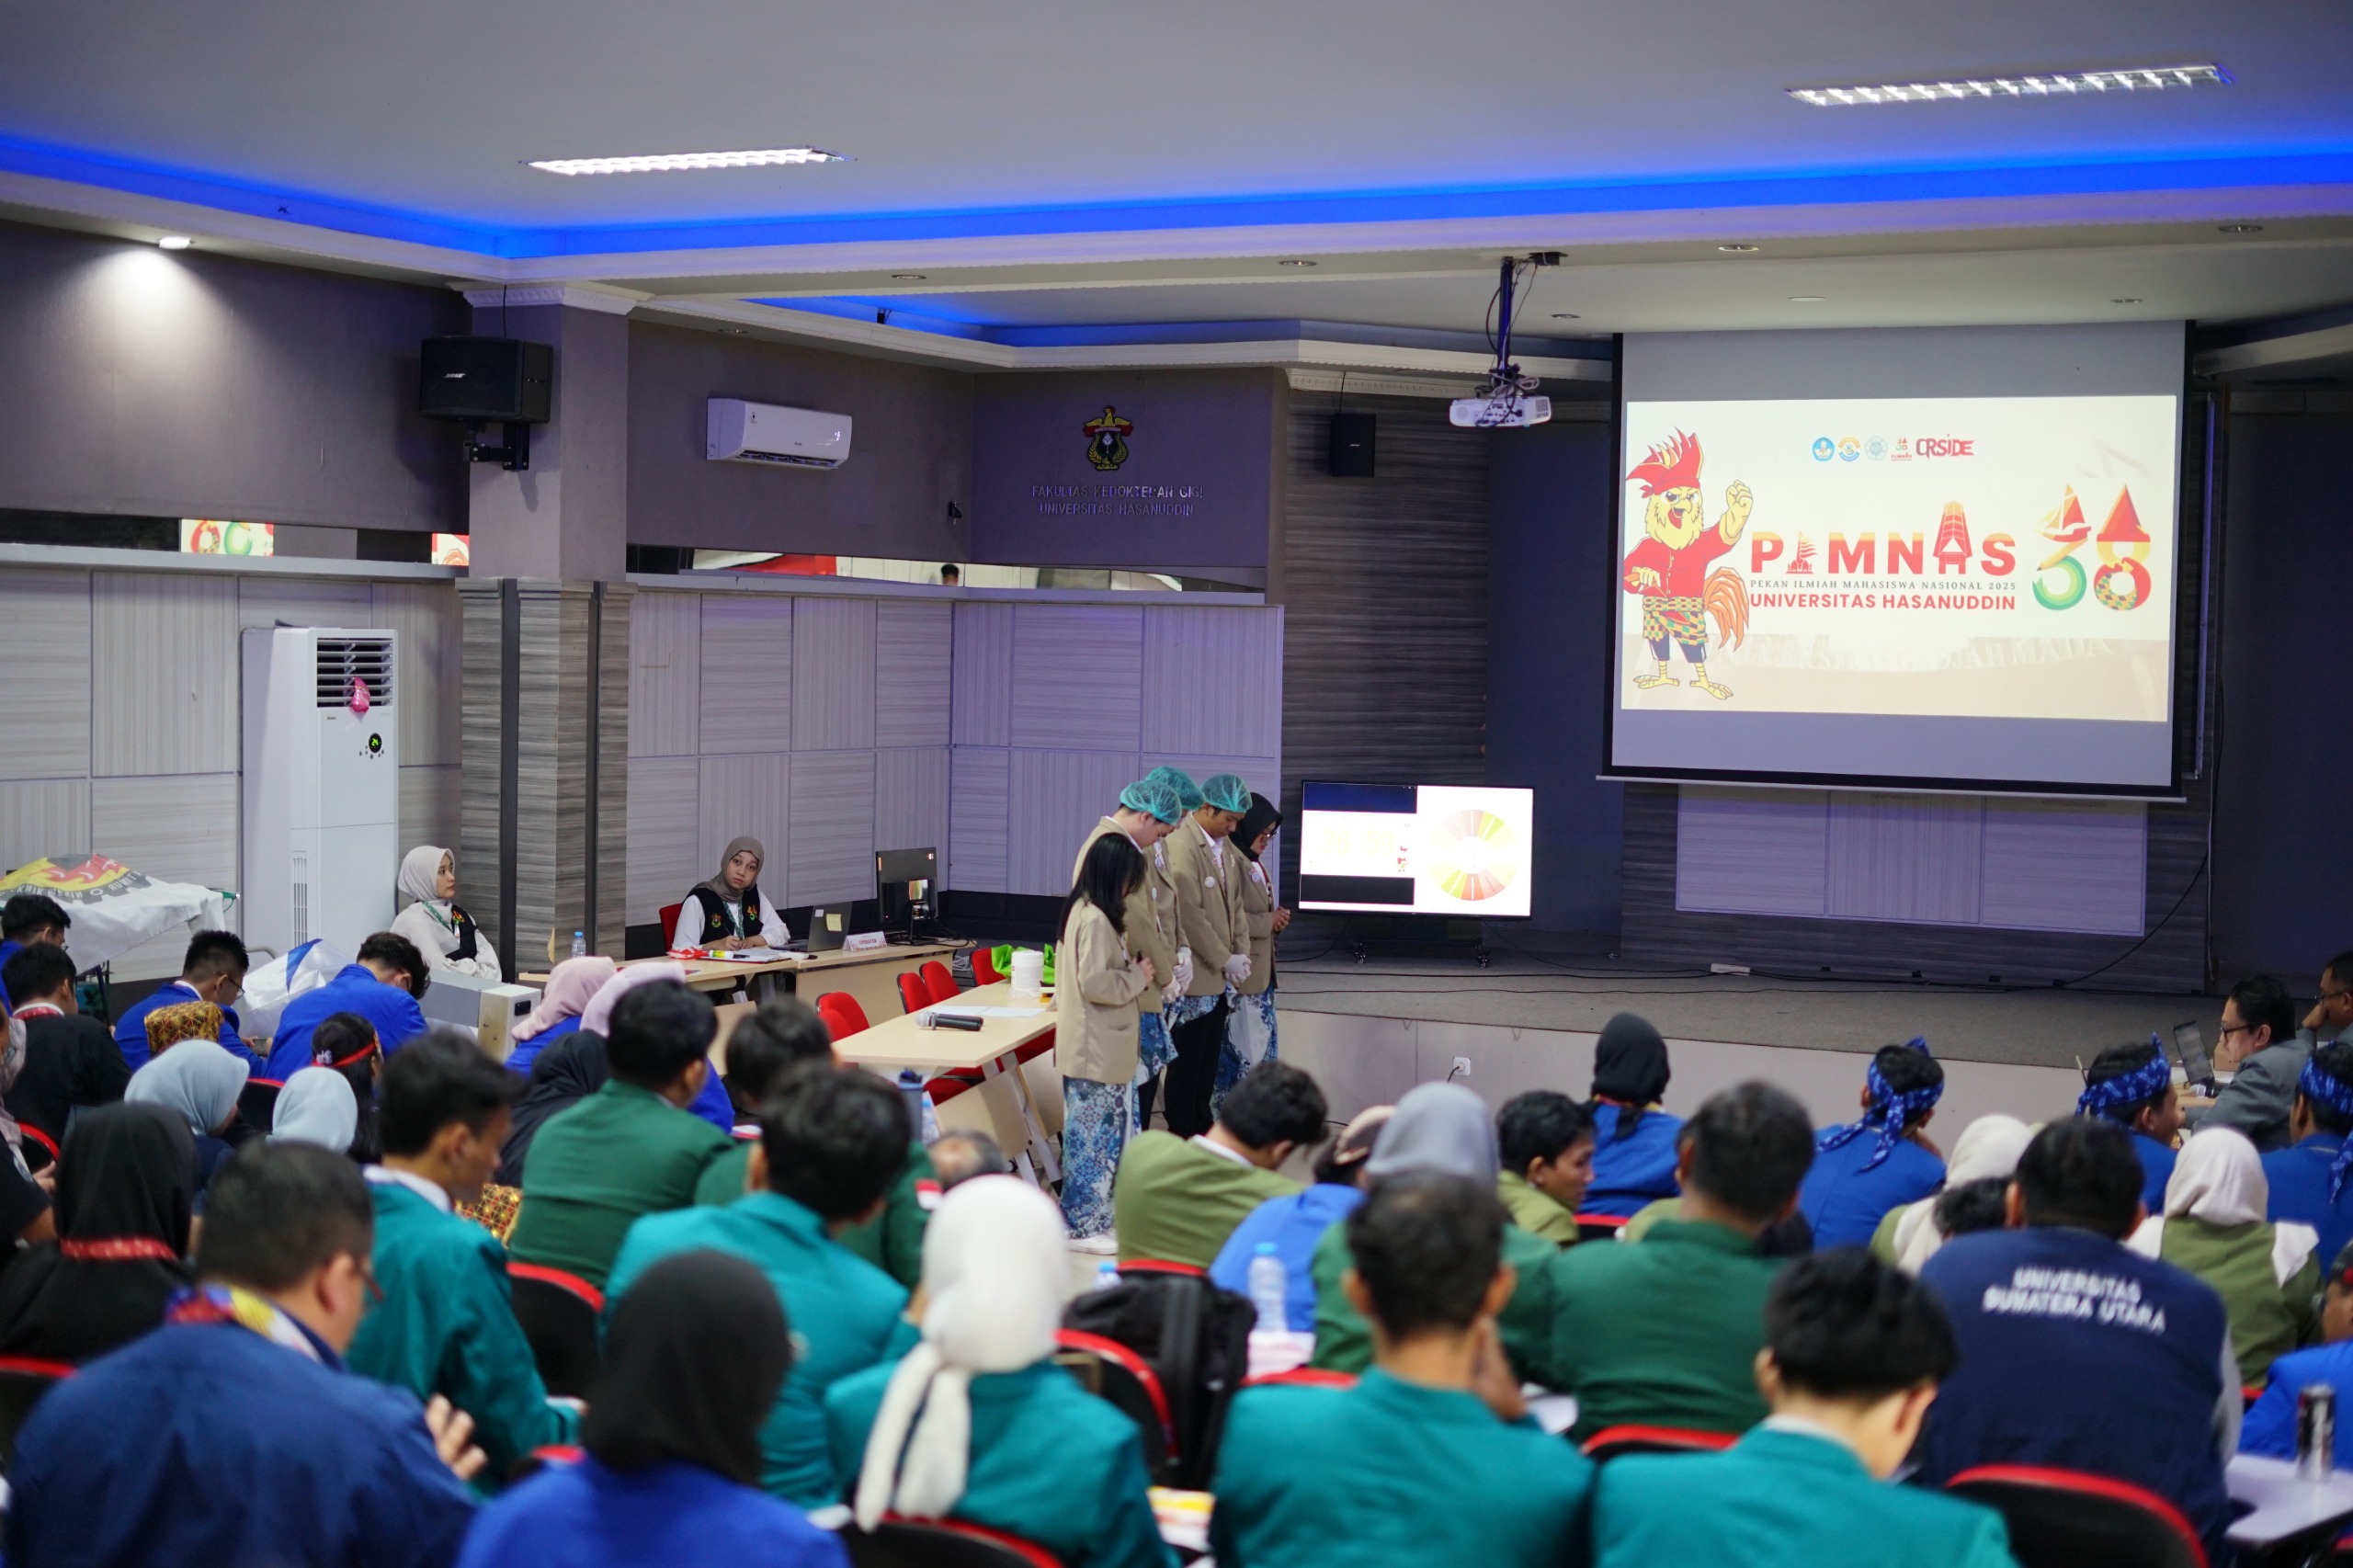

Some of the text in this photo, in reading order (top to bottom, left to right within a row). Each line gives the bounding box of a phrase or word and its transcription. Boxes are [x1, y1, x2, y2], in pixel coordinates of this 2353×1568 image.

[1032, 485, 1204, 498] FAKULTAS KEDOKTERAN GIGI
[1040, 503, 1194, 516] UNIVERSITAS HASANUDDIN
[1750, 580, 2016, 590] PEKAN ILMIAH MAHASISWA NASIONAL 2025
[1750, 593, 2016, 610] UNIVERSITAS HASANUDDIN
[2012, 1265, 2142, 1304] UNIVERSITAS
[1982, 1284, 2166, 1335] SUMATERA UTARA
